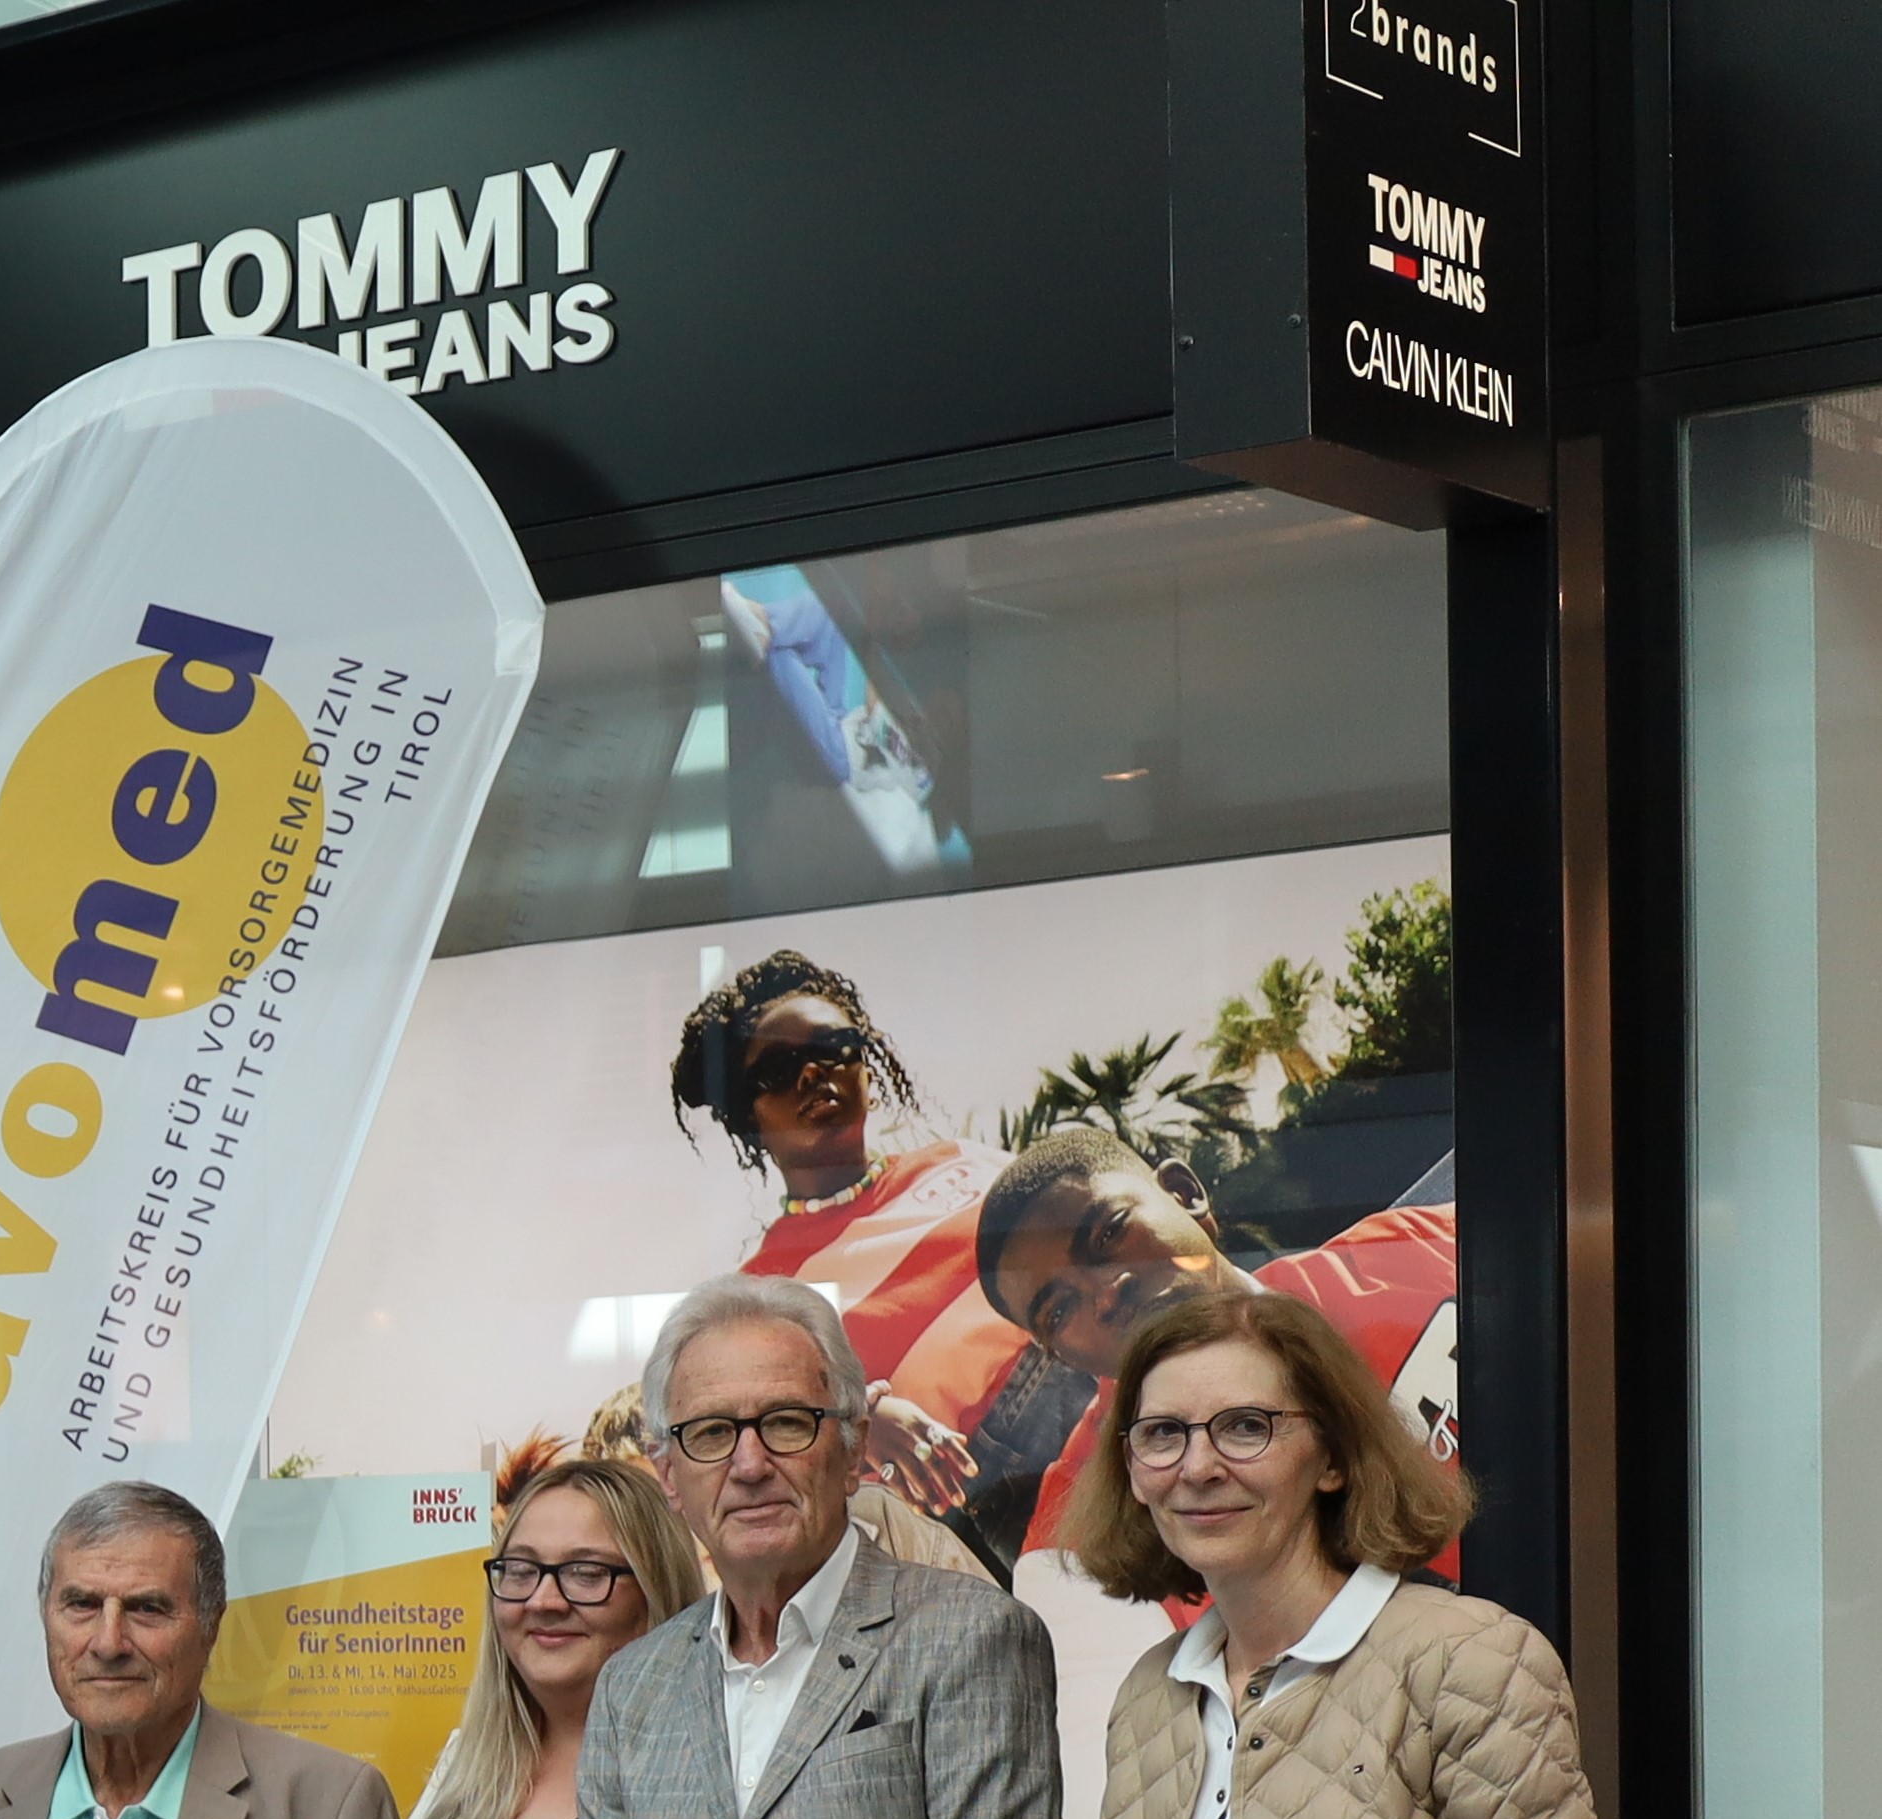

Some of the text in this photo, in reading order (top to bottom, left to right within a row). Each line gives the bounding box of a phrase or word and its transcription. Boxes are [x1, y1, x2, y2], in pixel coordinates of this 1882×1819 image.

[123, 147, 621, 348] TOMMY
[1368, 173, 1485, 269] TOMMY
[1417, 256, 1486, 313] JEANS
[1346, 320, 1514, 427] CALVIN KLEIN
[384, 688, 453, 804] TIROL
[62, 656, 364, 1452] ARBEITSKREIS FÜR VORSORGEMEDIZIN
[102, 669, 409, 1463] UND GESUNDHEITSFÖRDERUNG IN
[413, 1506, 477, 1524] BRUCK
[286, 1602, 464, 1630] Gesundheitstage
[298, 1631, 466, 1653] für SeniorInnen
[288, 1665, 304, 1681] Di,
[309, 1665, 329, 1679] 13.
[332, 1665, 341, 1679] &
[345, 1665, 364, 1681] Mi,
[394, 1664, 417, 1679] Mai
[422, 1663, 457, 1679] 2025
